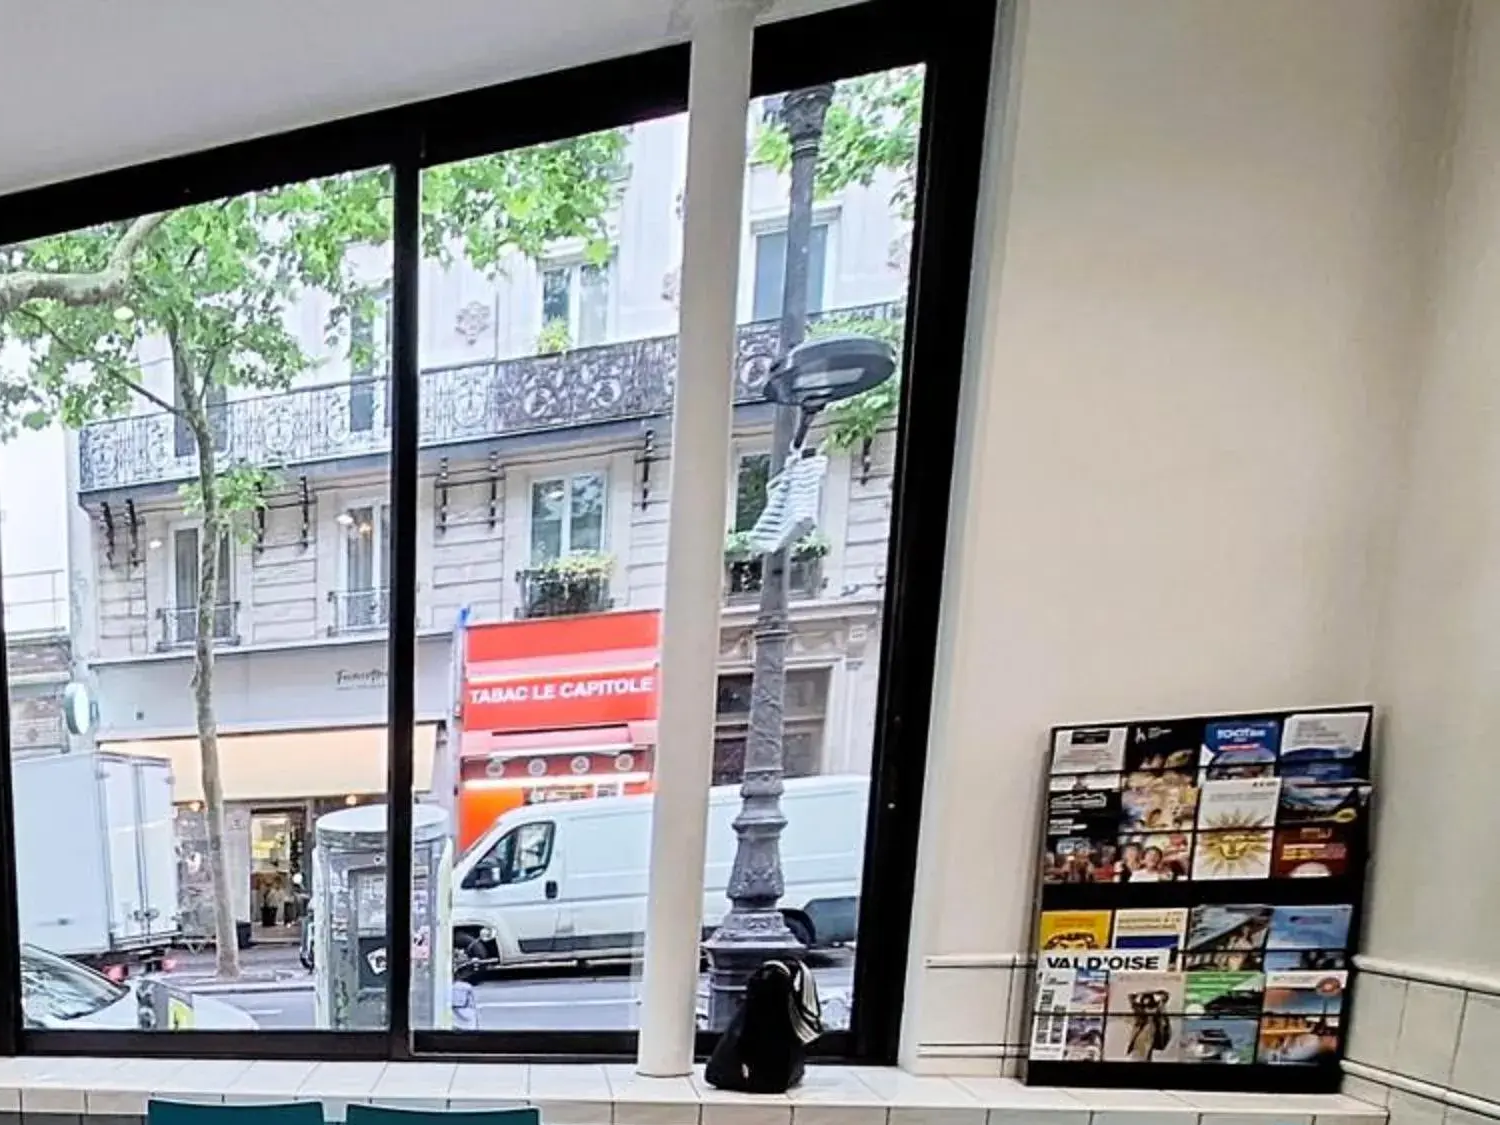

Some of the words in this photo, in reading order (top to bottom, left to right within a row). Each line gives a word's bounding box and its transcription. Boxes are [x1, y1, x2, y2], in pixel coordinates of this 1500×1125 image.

[469, 684, 529, 704] TABAC
[532, 682, 556, 700] LE
[560, 675, 655, 698] CAPITOLE
[1047, 956, 1083, 969] VAL
[1087, 956, 1160, 970] D'OISE
